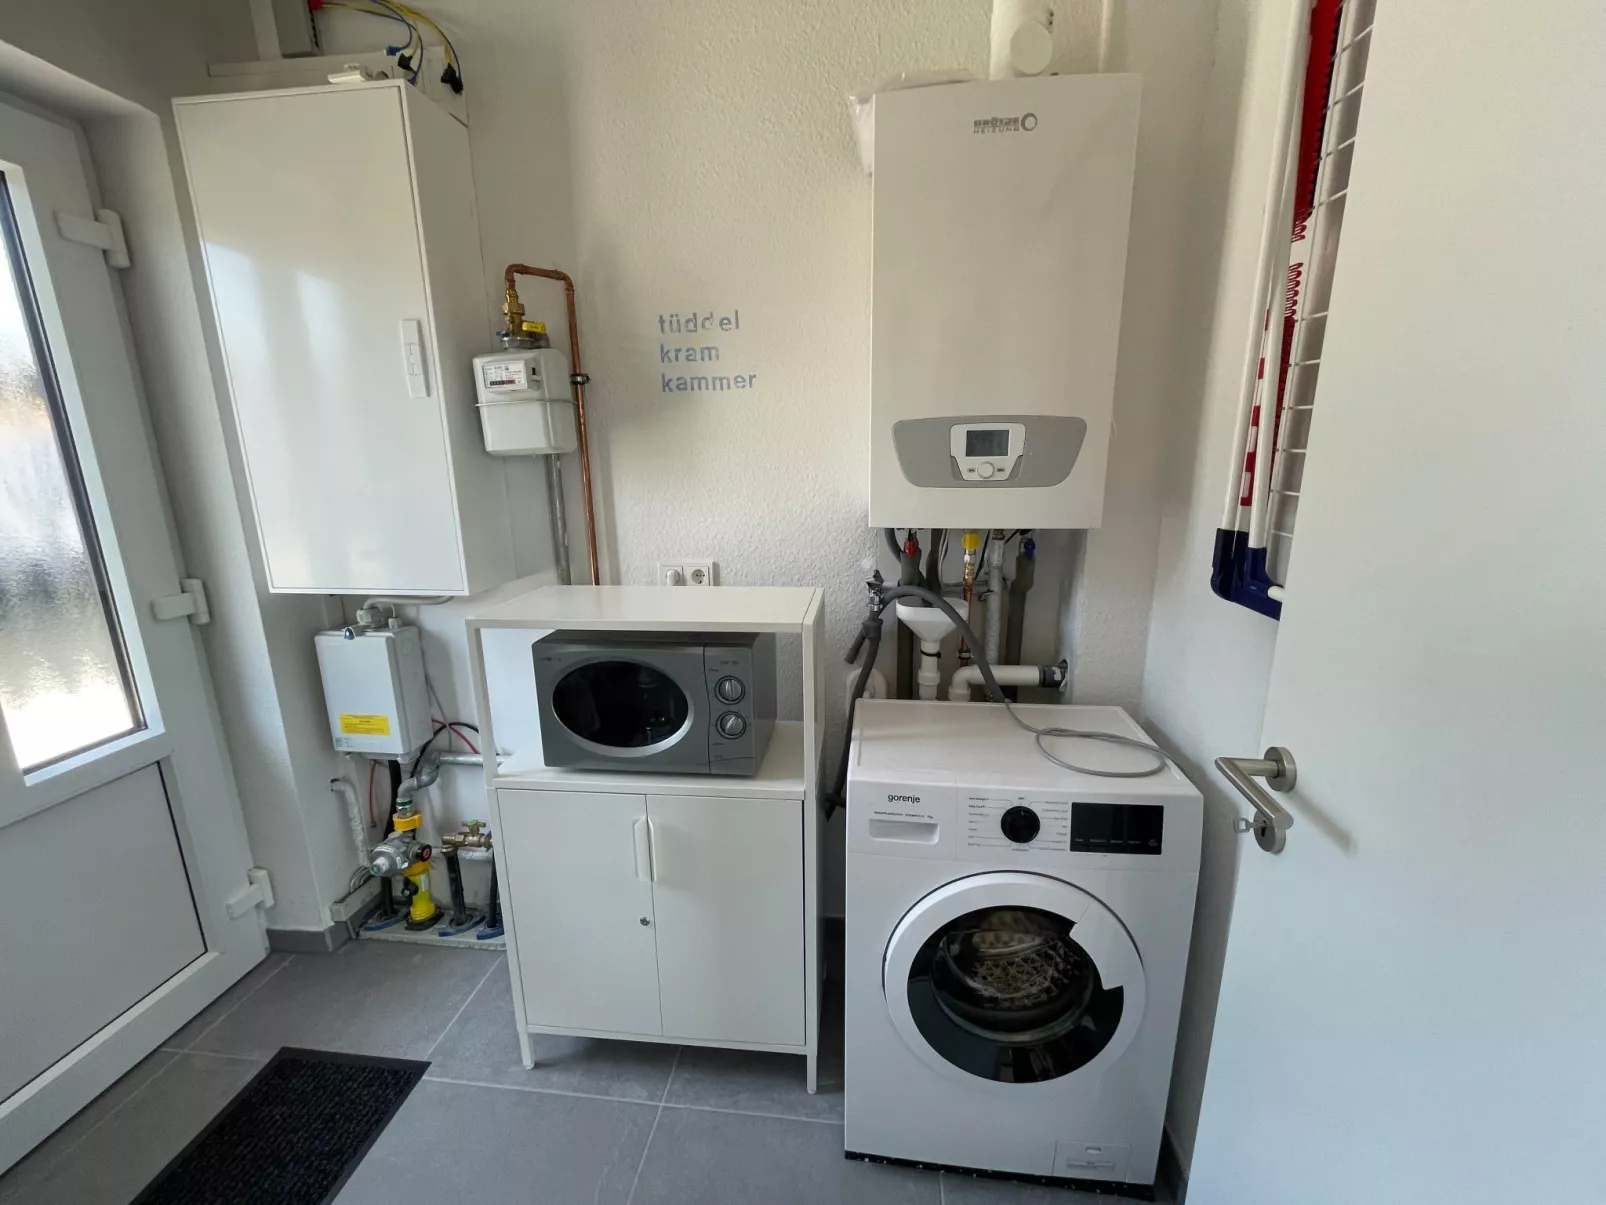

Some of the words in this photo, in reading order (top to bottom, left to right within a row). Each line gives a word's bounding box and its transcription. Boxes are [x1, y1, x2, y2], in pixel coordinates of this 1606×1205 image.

[658, 309, 740, 334] tüddel
[660, 344, 720, 363] kram
[661, 373, 757, 393] kammer
[887, 794, 921, 804] gorenje
